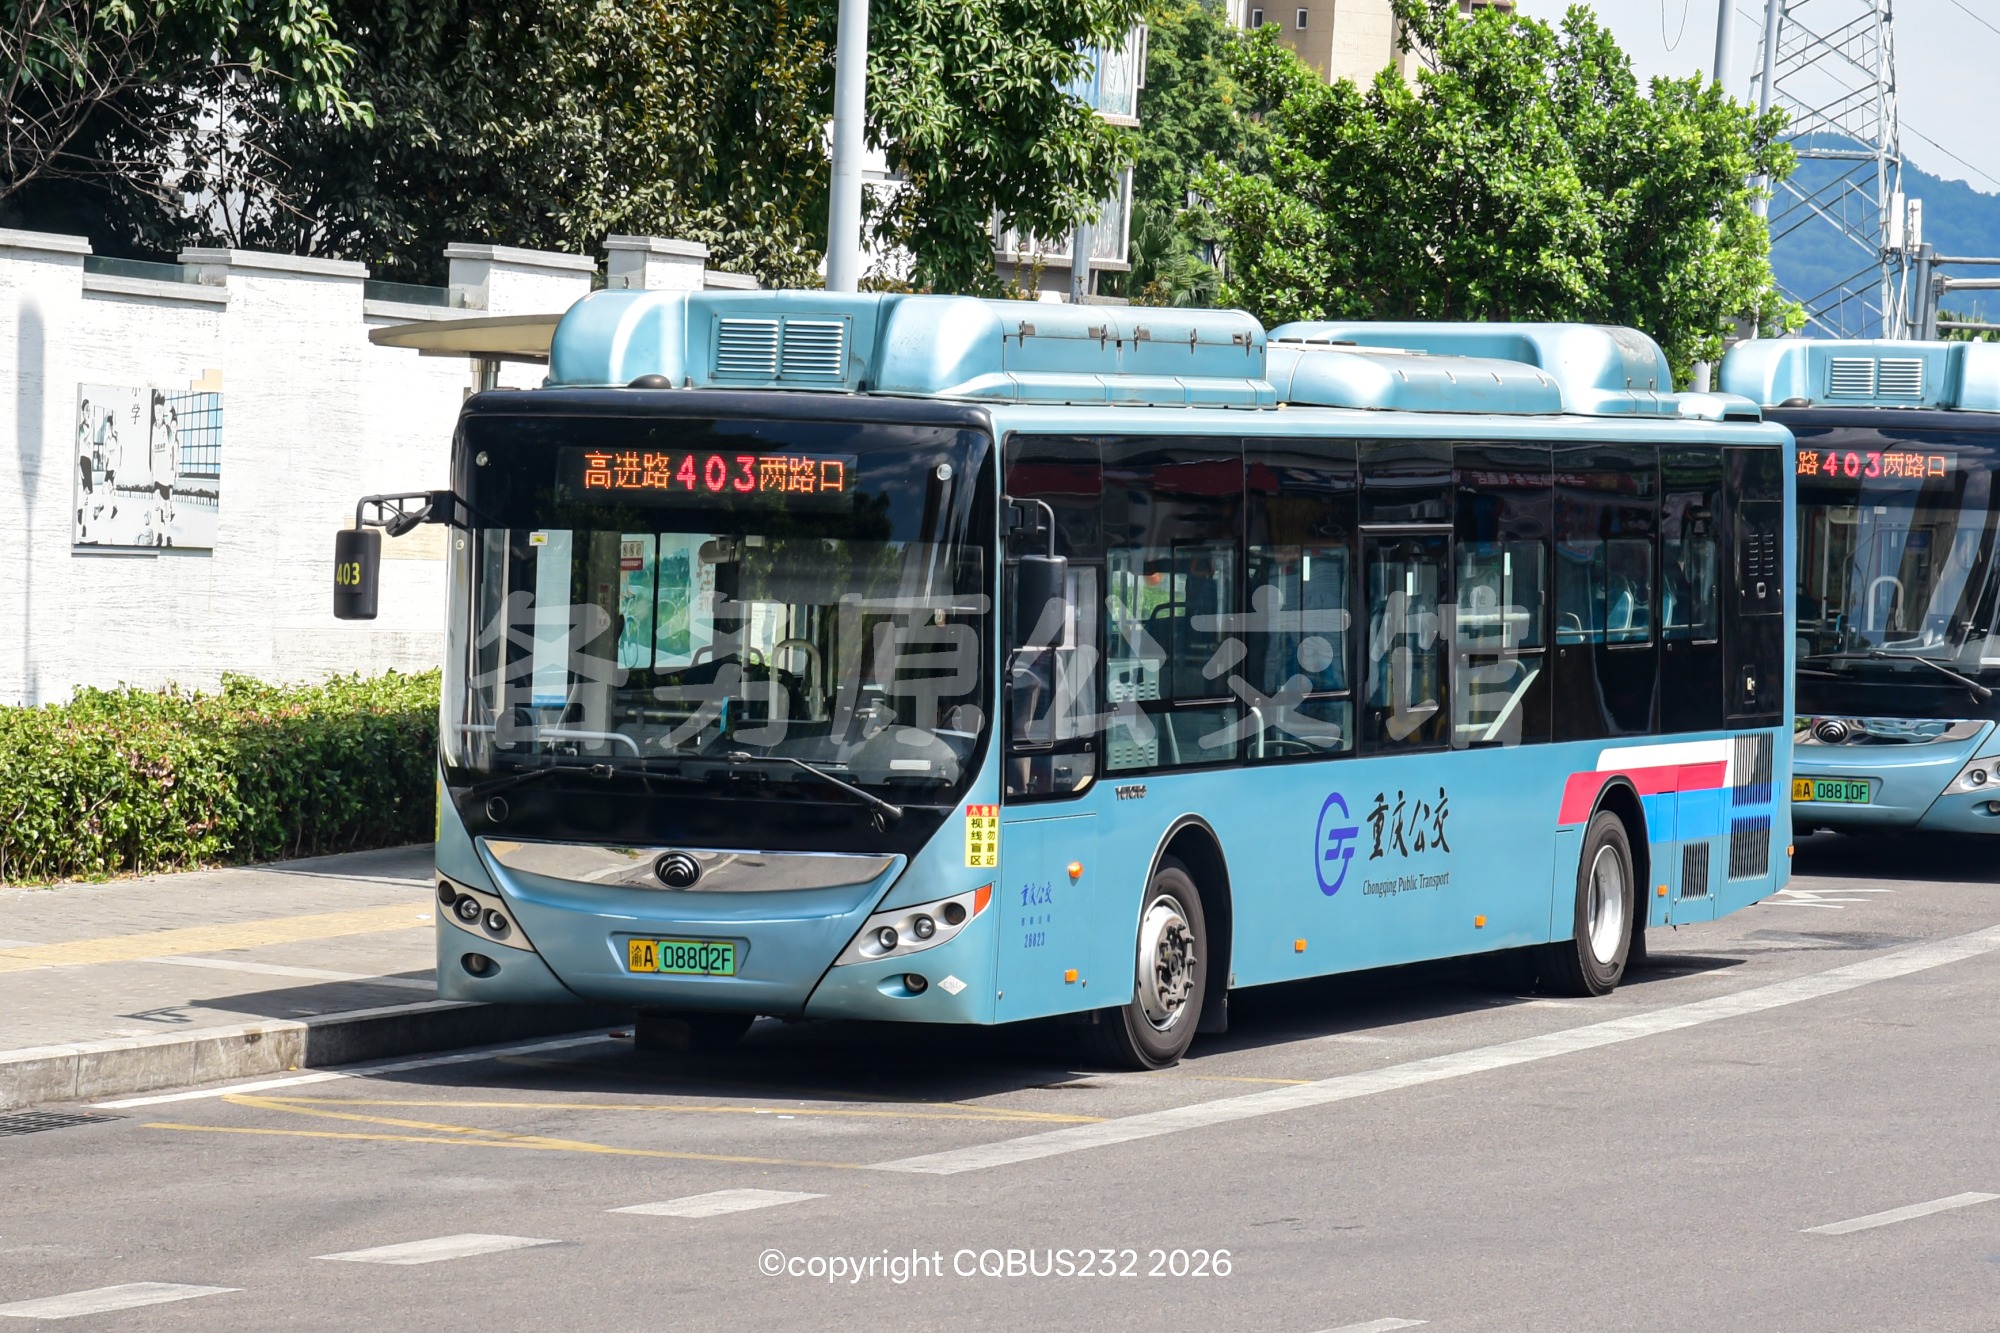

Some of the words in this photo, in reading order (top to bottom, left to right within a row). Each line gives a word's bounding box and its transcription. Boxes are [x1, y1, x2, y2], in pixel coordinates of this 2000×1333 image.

[585, 450, 671, 489] 高进路
[676, 454, 757, 491] 403
[759, 456, 843, 492] 两路口
[1796, 451, 1819, 476] 路
[1822, 452, 1881, 477] 403
[1883, 453, 1946, 478] 两路口
[336, 562, 361, 586] 403
[1366, 786, 1450, 861] 重庆公交
[971, 818, 983, 866] 视线盲区
[986, 818, 996, 866] 请勿靠近
[1020, 881, 1052, 907] 重庆公交
[1362, 878, 1397, 898] Chongqing
[1398, 874, 1418, 892] Public
[1419, 872, 1450, 891] Transport
[943, 981, 962, 989] CNG
